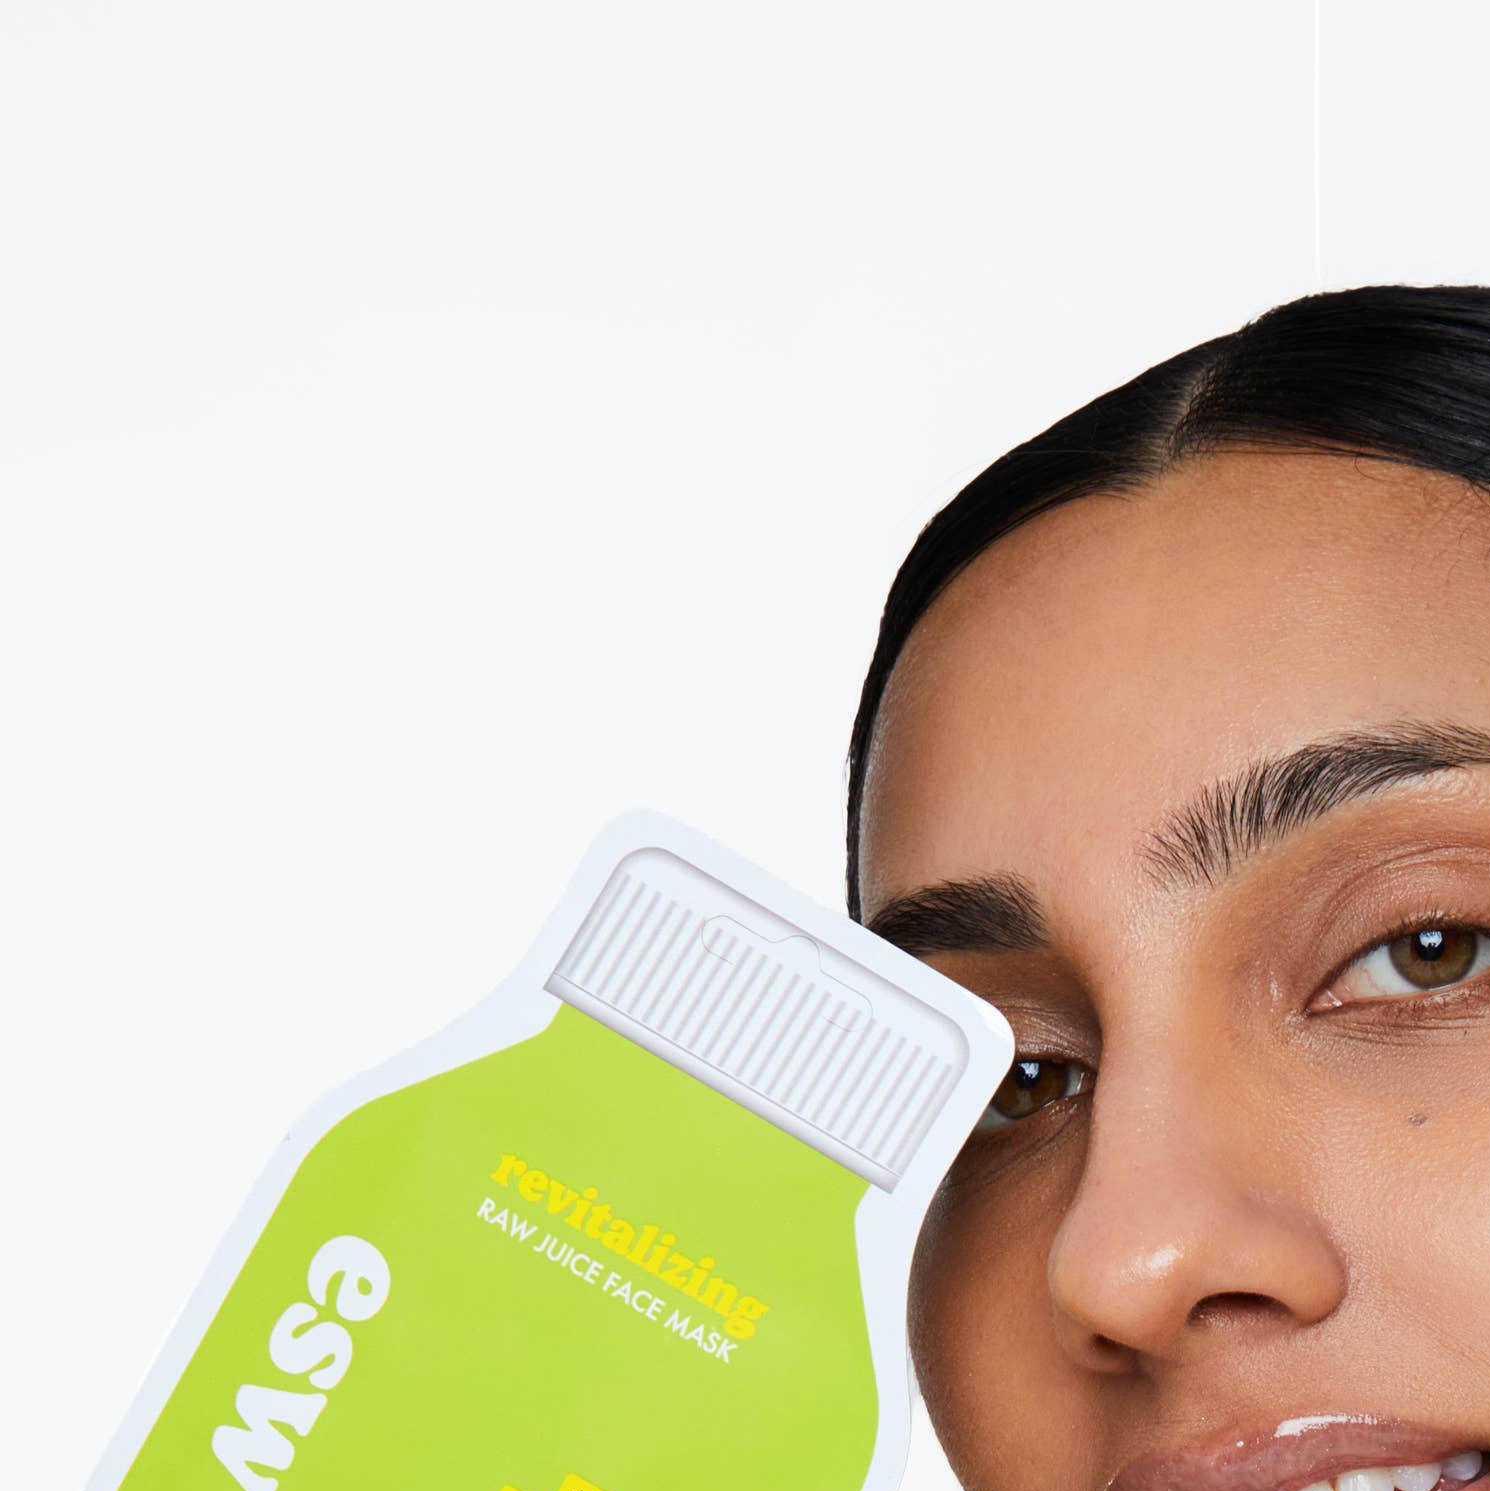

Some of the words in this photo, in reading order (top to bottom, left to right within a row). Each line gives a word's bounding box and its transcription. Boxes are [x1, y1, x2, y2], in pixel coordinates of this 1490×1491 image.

[476, 1195, 539, 1243] RAW
[532, 1232, 605, 1286] JUICE
[601, 1270, 666, 1321] FACE
[662, 1308, 739, 1364] MASK
[489, 1152, 771, 1341] revitalizing
